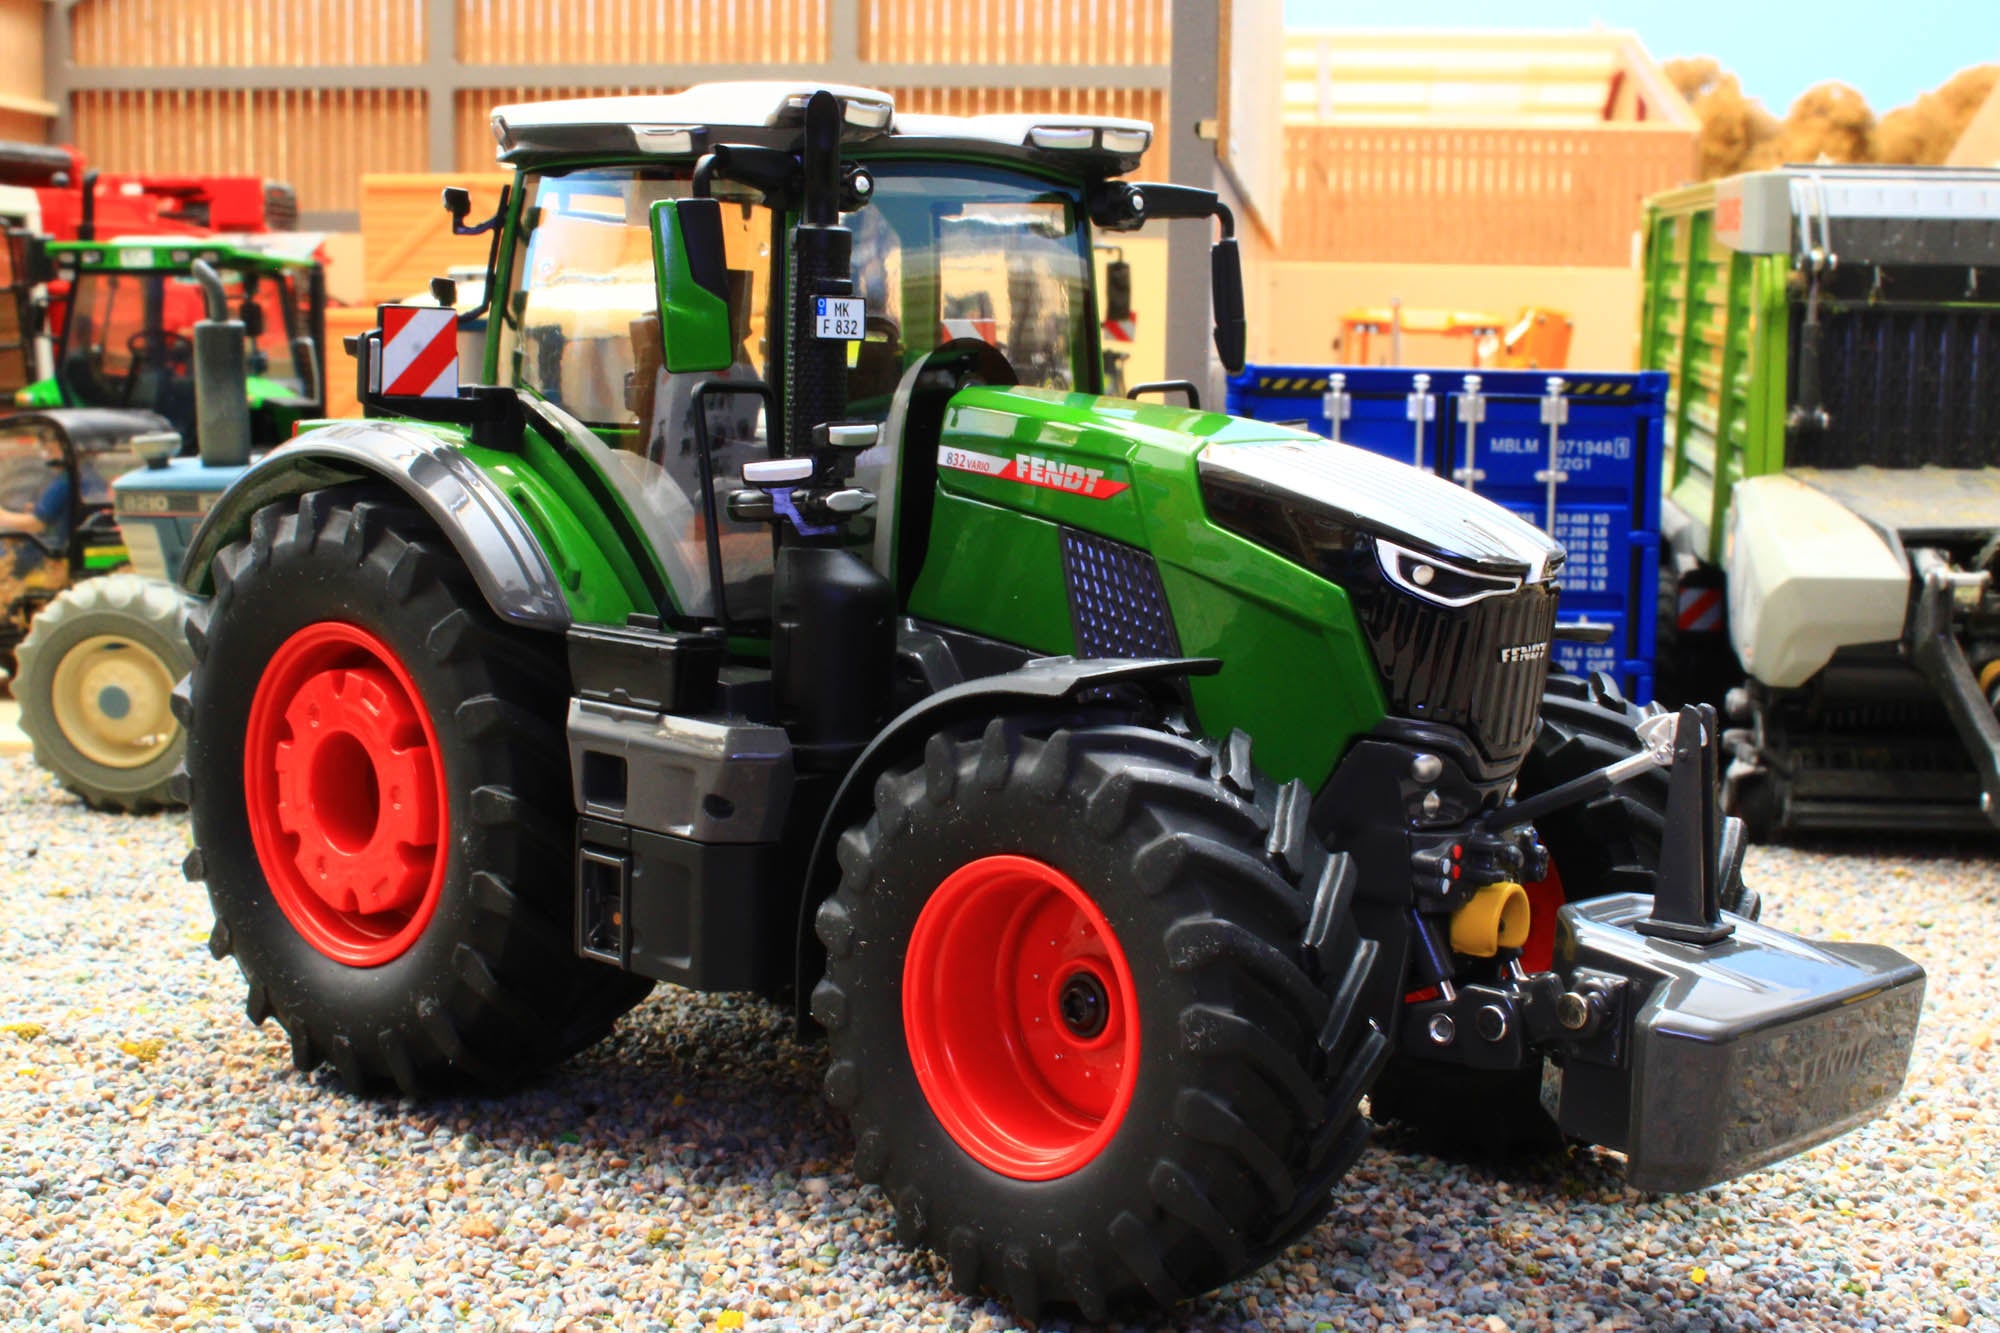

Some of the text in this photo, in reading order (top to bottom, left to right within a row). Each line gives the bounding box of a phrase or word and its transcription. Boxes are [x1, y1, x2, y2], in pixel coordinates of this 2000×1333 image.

[834, 302, 849, 317] MK
[823, 319, 858, 335] F 832
[1490, 437, 1539, 453] MBLM
[946, 452, 1104, 494] 832 VARIO FENDT
[1502, 642, 1547, 663] FENDT
